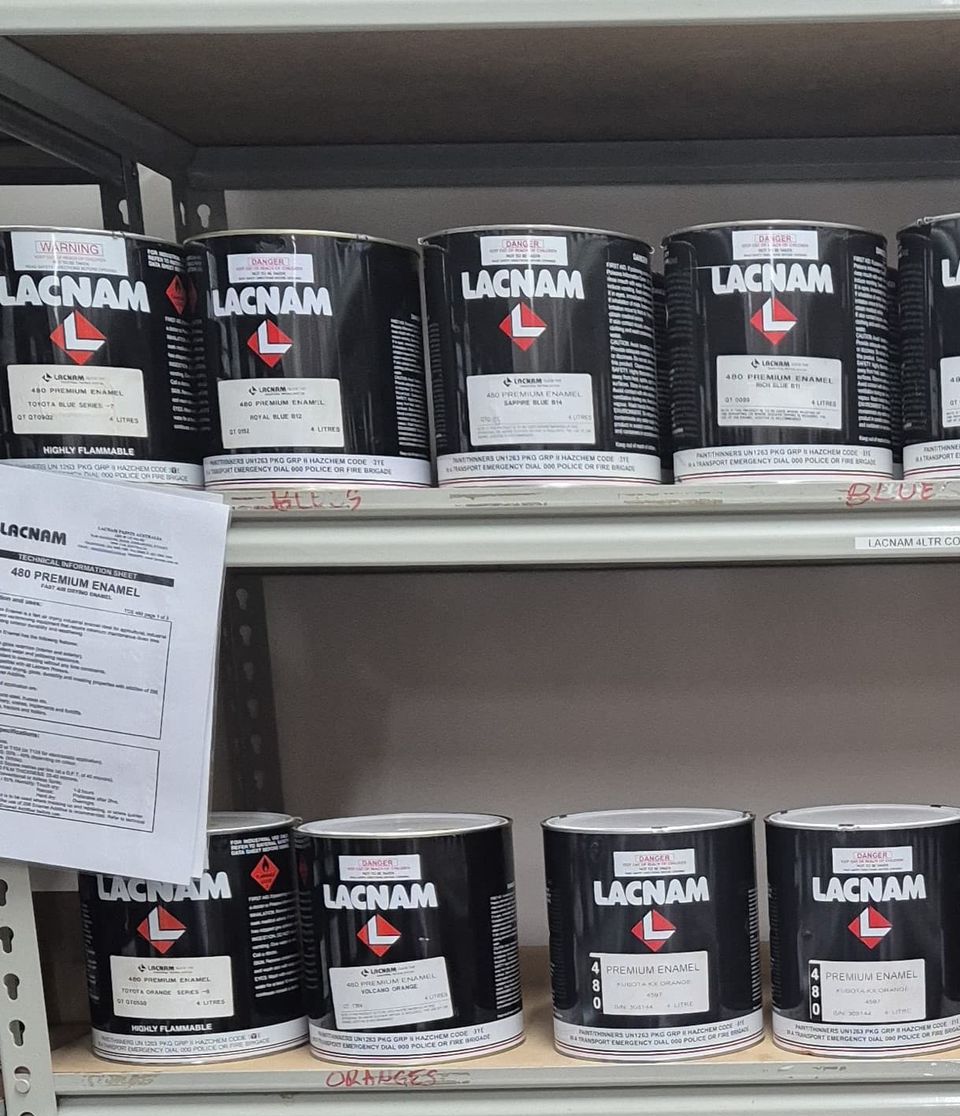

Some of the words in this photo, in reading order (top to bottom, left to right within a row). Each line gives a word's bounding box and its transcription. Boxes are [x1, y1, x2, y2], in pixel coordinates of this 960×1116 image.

[40, 242, 100, 254] WARNING
[251, 257, 285, 266] DANGER
[461, 269, 585, 299] LACNAM
[711, 264, 833, 294] LACNAM
[0, 275, 150, 313] LACNAM
[211, 287, 333, 316] LACNAM
[795, 376, 833, 384] ENAMEL
[91, 389, 124, 397] ENAMEL
[44, 446, 75, 455] HIGHLY
[78, 447, 134, 456] FLAMMABLE
[273, 466, 289, 474] DIAL
[305, 466, 330, 474] POLICE
[846, 482, 933, 507] BLUE
[0, 522, 66, 545] LACNAM
[868, 538, 913, 547] LACNAM
[916, 538, 941, 547] 4LTR
[19, 554, 60, 567] TECHNICAL
[62, 561, 112, 575] INFORMATION
[114, 569, 138, 580] SHEET
[11, 567, 31, 579] 480
[34, 571, 89, 589] PREMIUM
[92, 581, 140, 597] ENAMEL
[323, 882, 438, 910] LACNAM
[593, 876, 709, 905] LACNAM
[813, 874, 926, 902] LACNAM
[607, 966, 655, 974] PREMIUM
[658, 963, 700, 973] ENAMEL
[826, 972, 873, 981] PREMIUM
[876, 971, 918, 980] ENAMEL
[160, 1023, 213, 1032] FLAMMABLE
